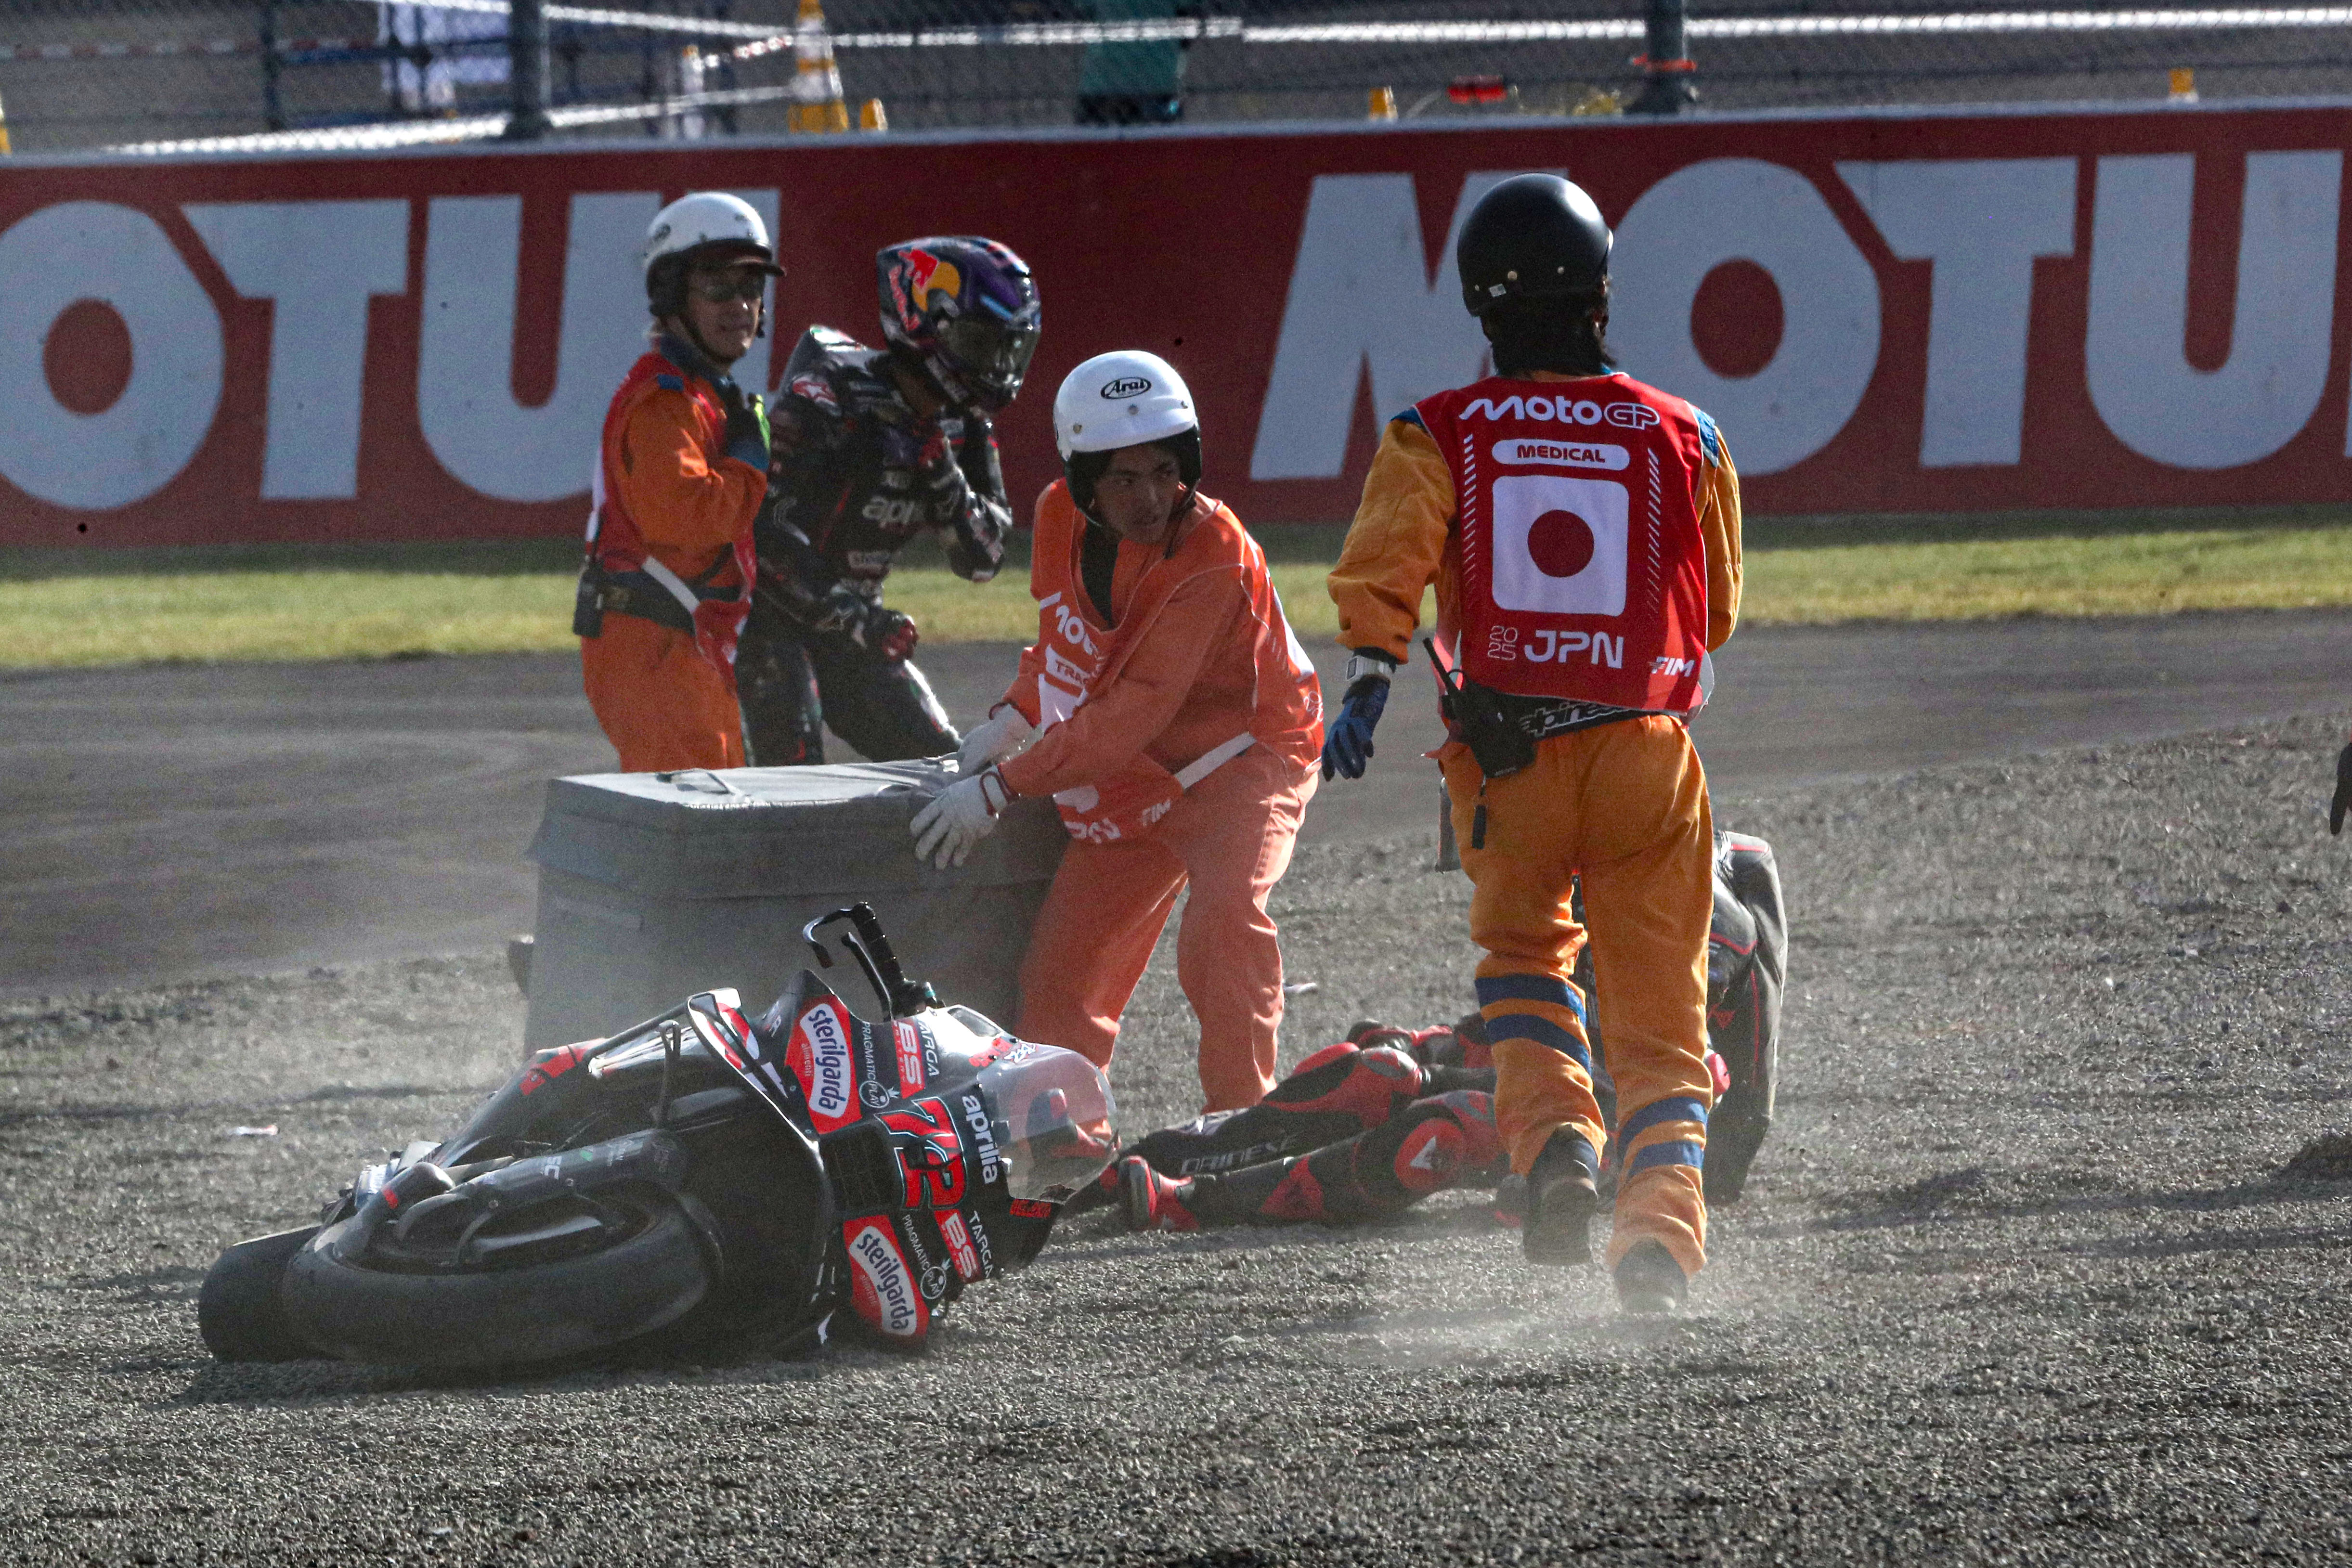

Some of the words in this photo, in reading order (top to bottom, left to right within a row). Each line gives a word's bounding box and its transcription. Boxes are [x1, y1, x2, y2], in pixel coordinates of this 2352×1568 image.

[1248, 150, 2352, 480] MOTU
[1105, 379, 1145, 397] Arai
[1517, 444, 1605, 463] MEDICAL
[1524, 630, 1624, 668] JPN
[1650, 656, 1695, 677] FIM
[808, 1009, 844, 1111] sterilgarda
[862, 1021, 876, 1080] PRAGMATIC
[898, 1022, 922, 1084] BS
[918, 1022, 940, 1076] ARGA
[868, 1083, 880, 1106] PLAY
[962, 1094, 998, 1184] aprilia
[902, 1215, 930, 1270] PRAGMATIC
[945, 1213, 976, 1278] BS
[969, 1210, 993, 1278] TARGA
[857, 1232, 914, 1331] sterilgarda
